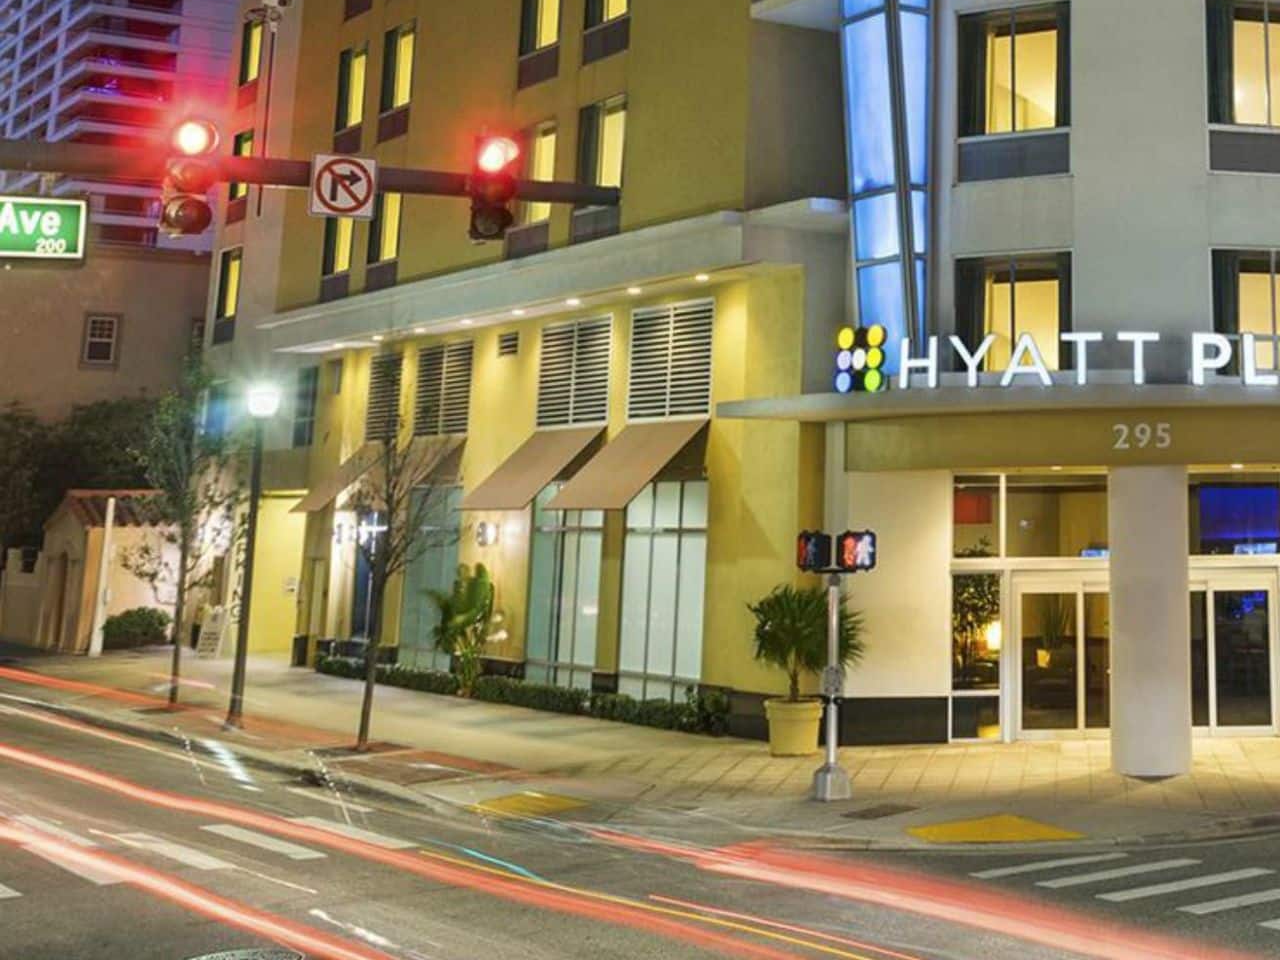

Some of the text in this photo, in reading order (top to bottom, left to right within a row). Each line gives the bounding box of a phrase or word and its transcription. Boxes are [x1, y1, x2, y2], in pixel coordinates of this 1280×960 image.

[0, 202, 62, 237] Ave
[35, 238, 67, 254] 200
[898, 331, 1160, 389] HYATT
[1111, 423, 1172, 450] 295
